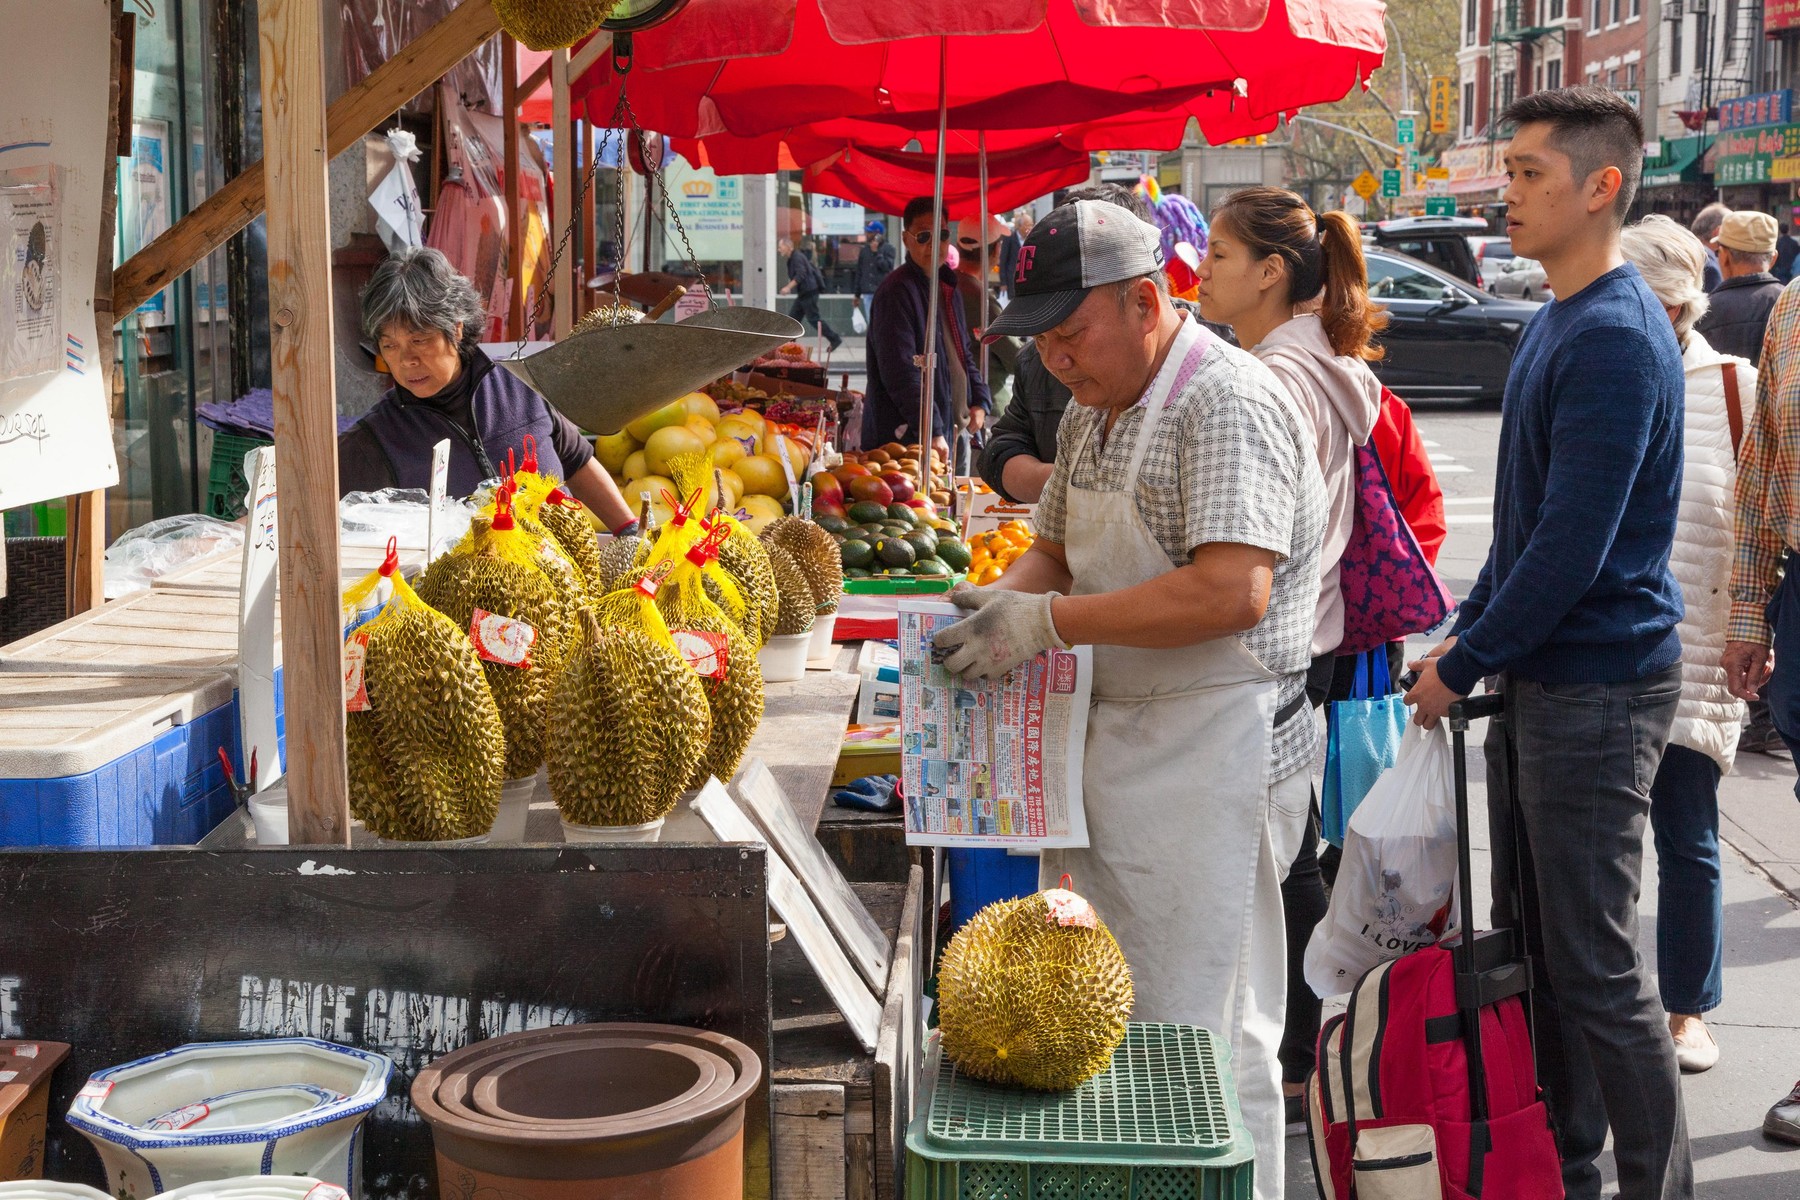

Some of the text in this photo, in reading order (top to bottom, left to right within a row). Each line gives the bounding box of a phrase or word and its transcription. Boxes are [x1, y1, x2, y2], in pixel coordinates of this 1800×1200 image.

[1436, 81, 1445, 121] PARK
[1016, 246, 1036, 283] T
[1056, 655, 1073, 692] 分類
[239, 976, 356, 1042] DANCE
